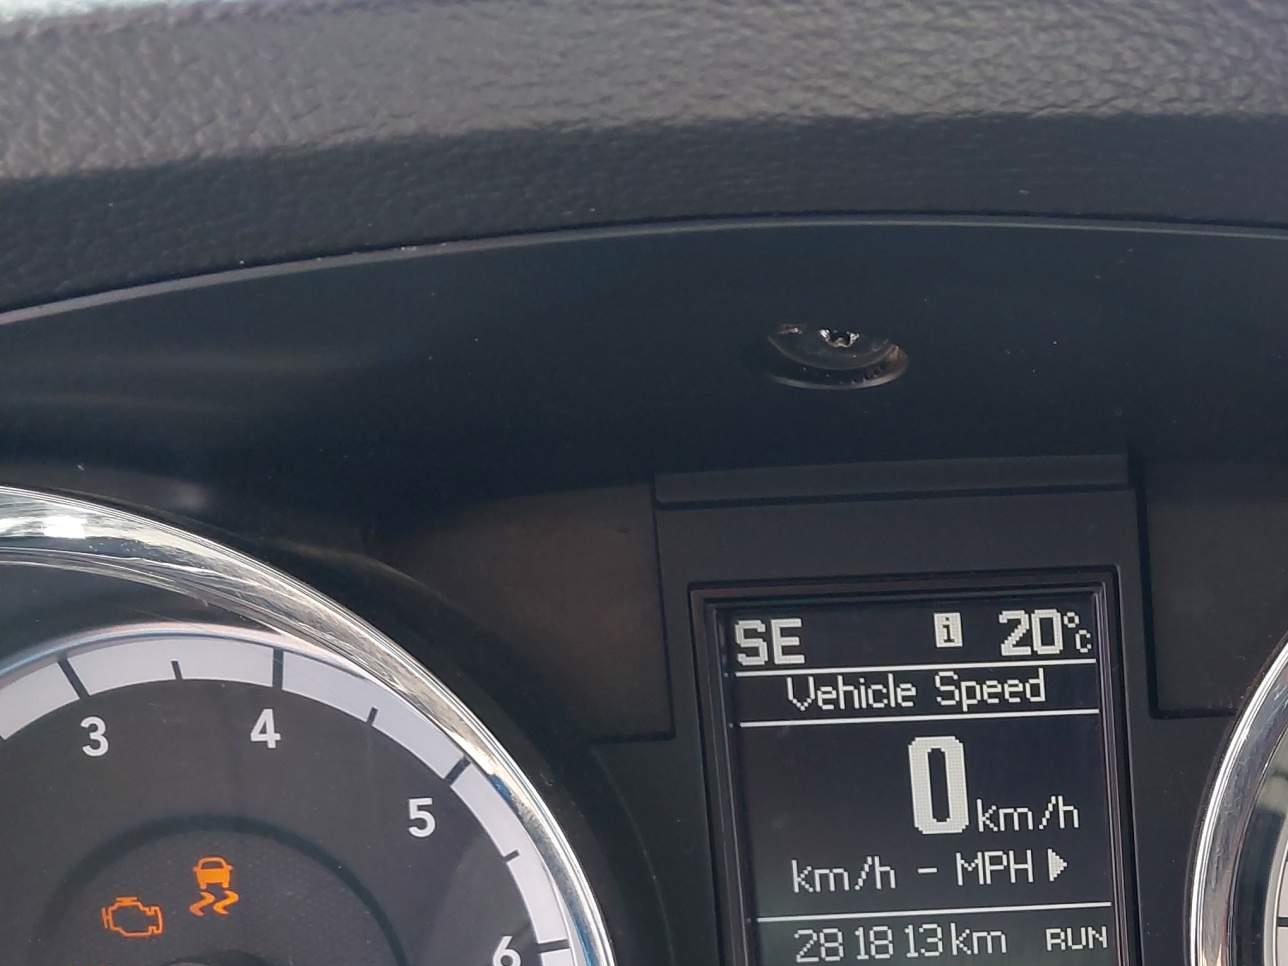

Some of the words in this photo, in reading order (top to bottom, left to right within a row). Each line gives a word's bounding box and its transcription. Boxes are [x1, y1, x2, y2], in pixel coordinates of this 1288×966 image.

[735, 618, 805, 665] SE
[787, 674, 917, 711] Vehicle
[934, 668, 1046, 712] Speed
[81, 716, 110, 756] 3
[249, 709, 281, 749] 4
[908, 736, 970, 835] 0
[977, 796, 1080, 832] km/h
[408, 798, 436, 837] 5
[791, 856, 896, 893] km/h
[955, 849, 1034, 886] MPH
[1045, 926, 1108, 952] RUN
